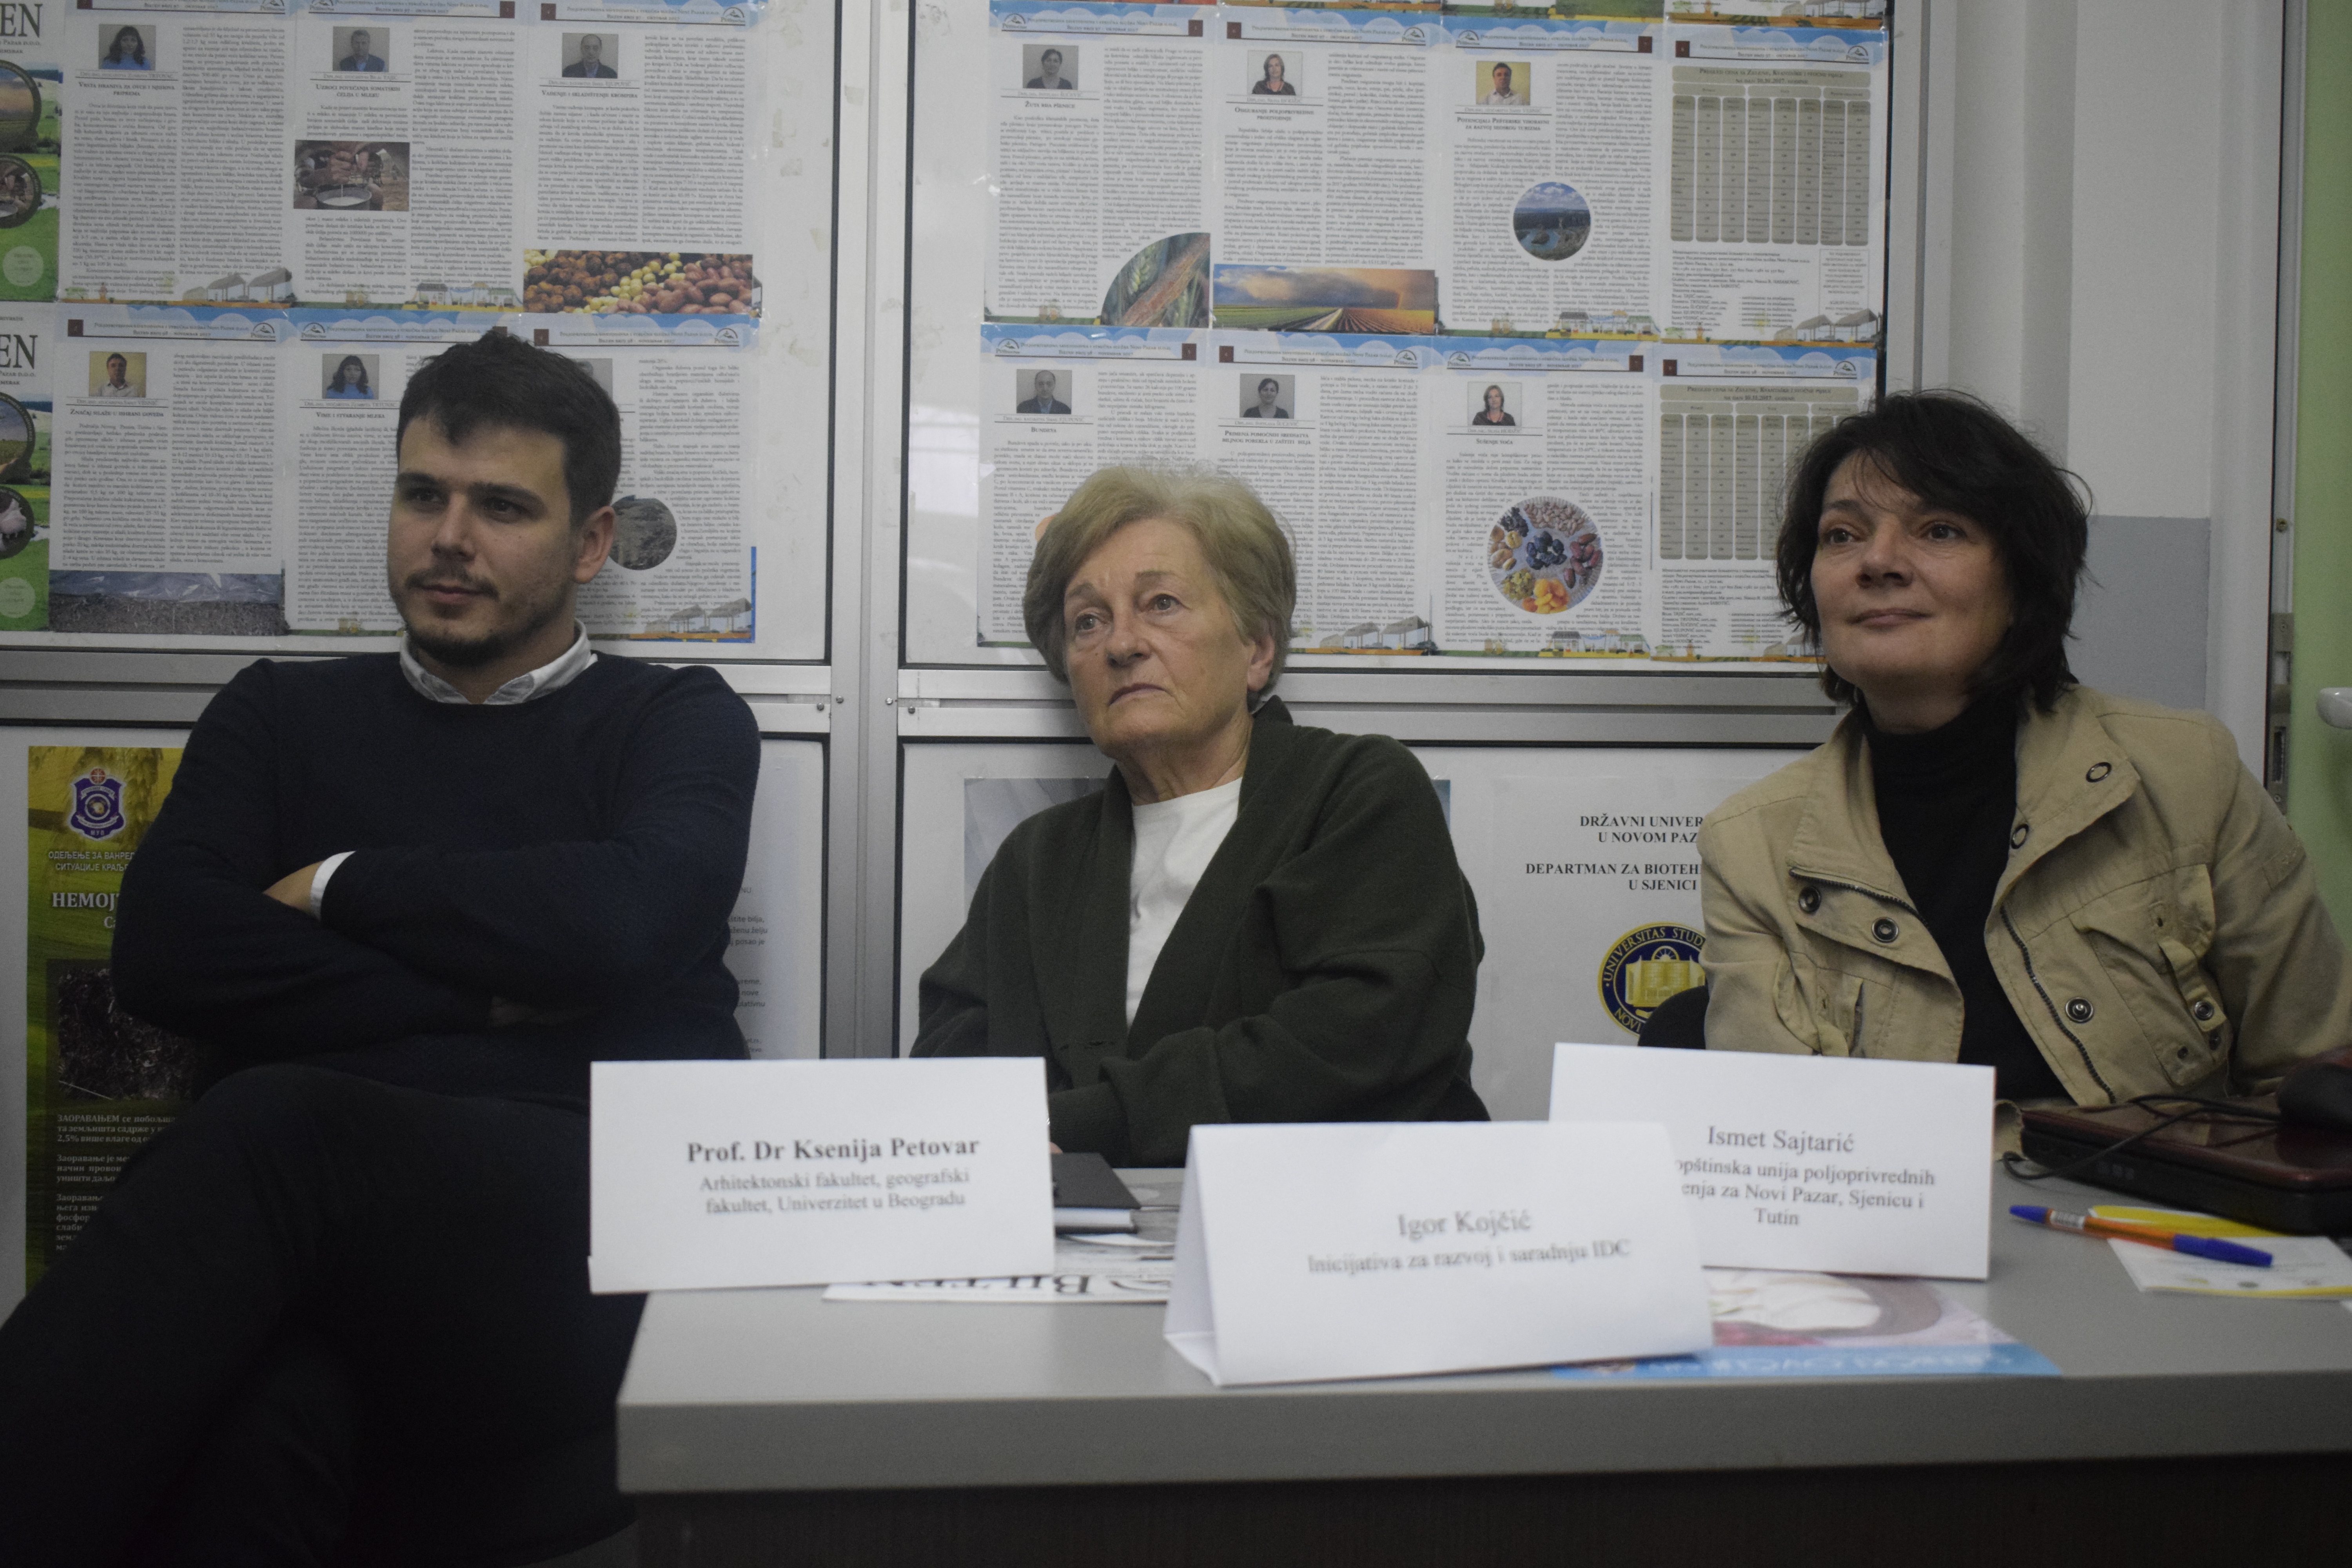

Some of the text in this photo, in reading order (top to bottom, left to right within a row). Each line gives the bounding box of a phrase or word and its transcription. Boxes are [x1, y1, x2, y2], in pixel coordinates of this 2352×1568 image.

[0, 3, 43, 38] EN
[0, 334, 38, 369] EN
[1580, 813, 1703, 827] DRŽAVNI UNIVER
[1598, 832, 1698, 842] U NOVOM PAZ
[55, 863, 100, 872] СИТУАЦИЈЕ
[1526, 864, 1701, 874] DEPARTMAN ZA BIOTEH
[1629, 879, 1697, 890] U SJENICI
[1603, 927, 1704, 981] UNIVERSITAS STUD
[1615, 1007, 1641, 1032] NOVI
[58, 1114, 120, 1123] ЗАОРАВАЊЕМ
[688, 1138, 980, 1163] Prof. Dr Ksenija Petovar
[1707, 1125, 1855, 1156] Ismet Sajtarić
[57, 1154, 106, 1163] Заоравање
[700, 1167, 969, 1191] Arhitektonski fakultet, geografski
[1675, 1157, 1936, 1186] opštinska unija poljoprivrednih
[706, 1191, 966, 1214] fakultet, Univerzitet u Beogradu
[1681, 1180, 1924, 1211] enja za Novi Pazar, Sjenicu i
[1396, 1209, 1532, 1243] Igor Kojčić
[1754, 1207, 1800, 1226] Tutin
[1307, 1238, 1632, 1277] Inicijativa za razvoj i saradnju IDC
